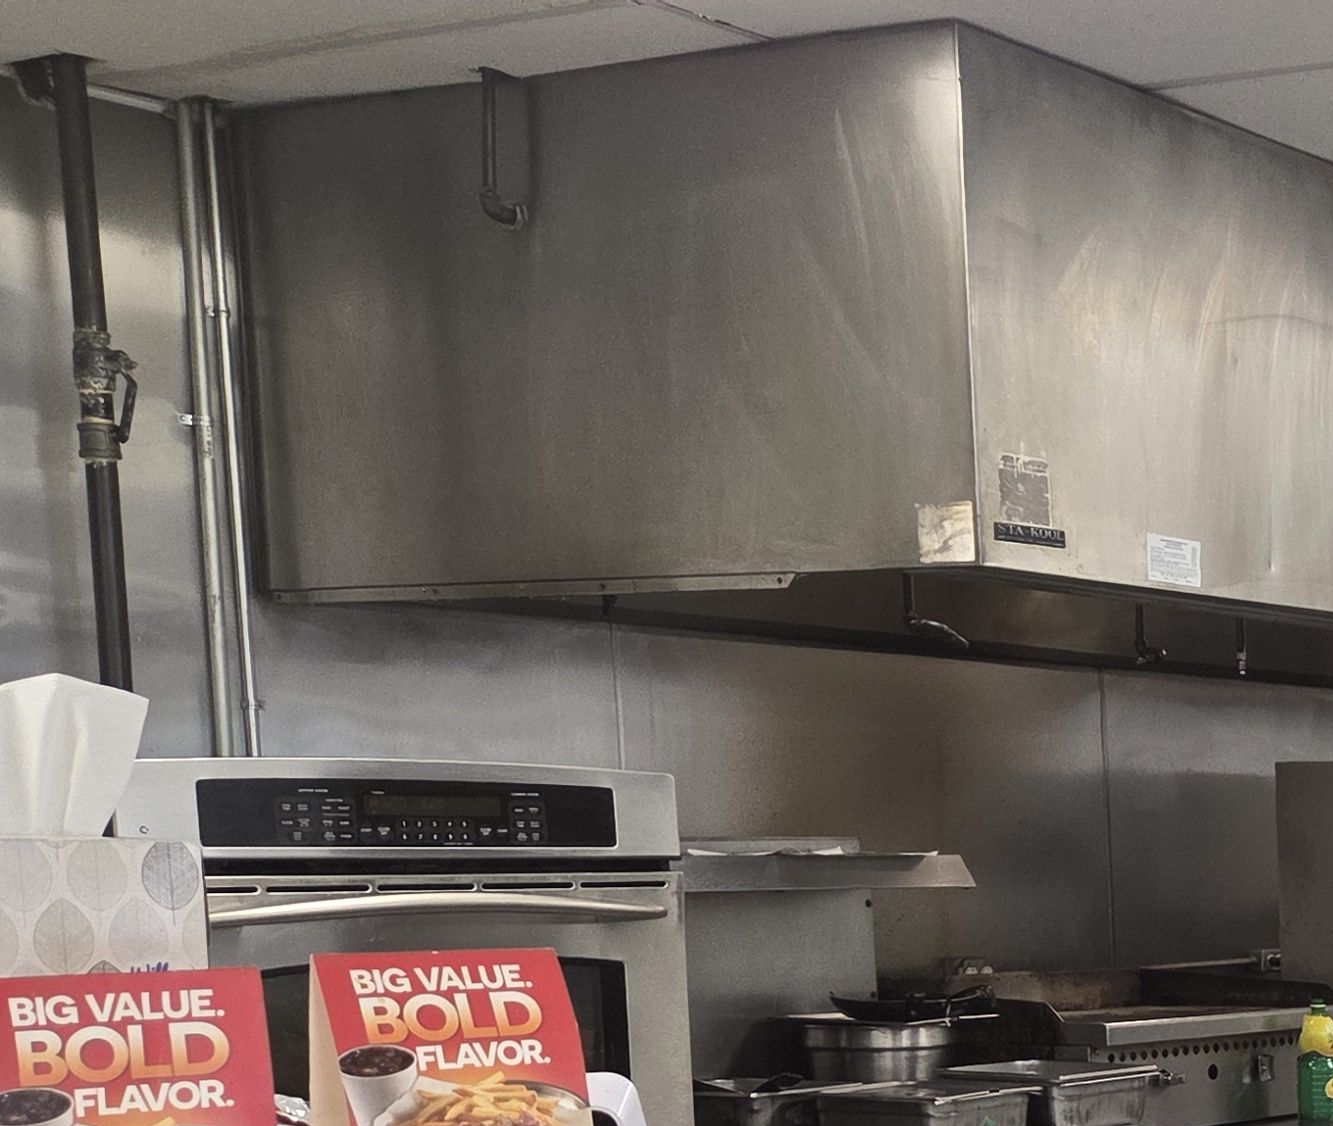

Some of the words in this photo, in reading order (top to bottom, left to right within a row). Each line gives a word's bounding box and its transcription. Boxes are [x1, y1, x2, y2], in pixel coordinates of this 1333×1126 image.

[349, 968, 412, 995] BIG
[414, 964, 533, 992] VALUE.
[8, 995, 79, 1027] BIG
[85, 989, 225, 1022] VALUE.
[358, 991, 542, 1044] BOLD
[14, 1021, 230, 1087] BOLD
[416, 1039, 551, 1072] FLAVOR.
[74, 1079, 235, 1117] FLAVOR.
